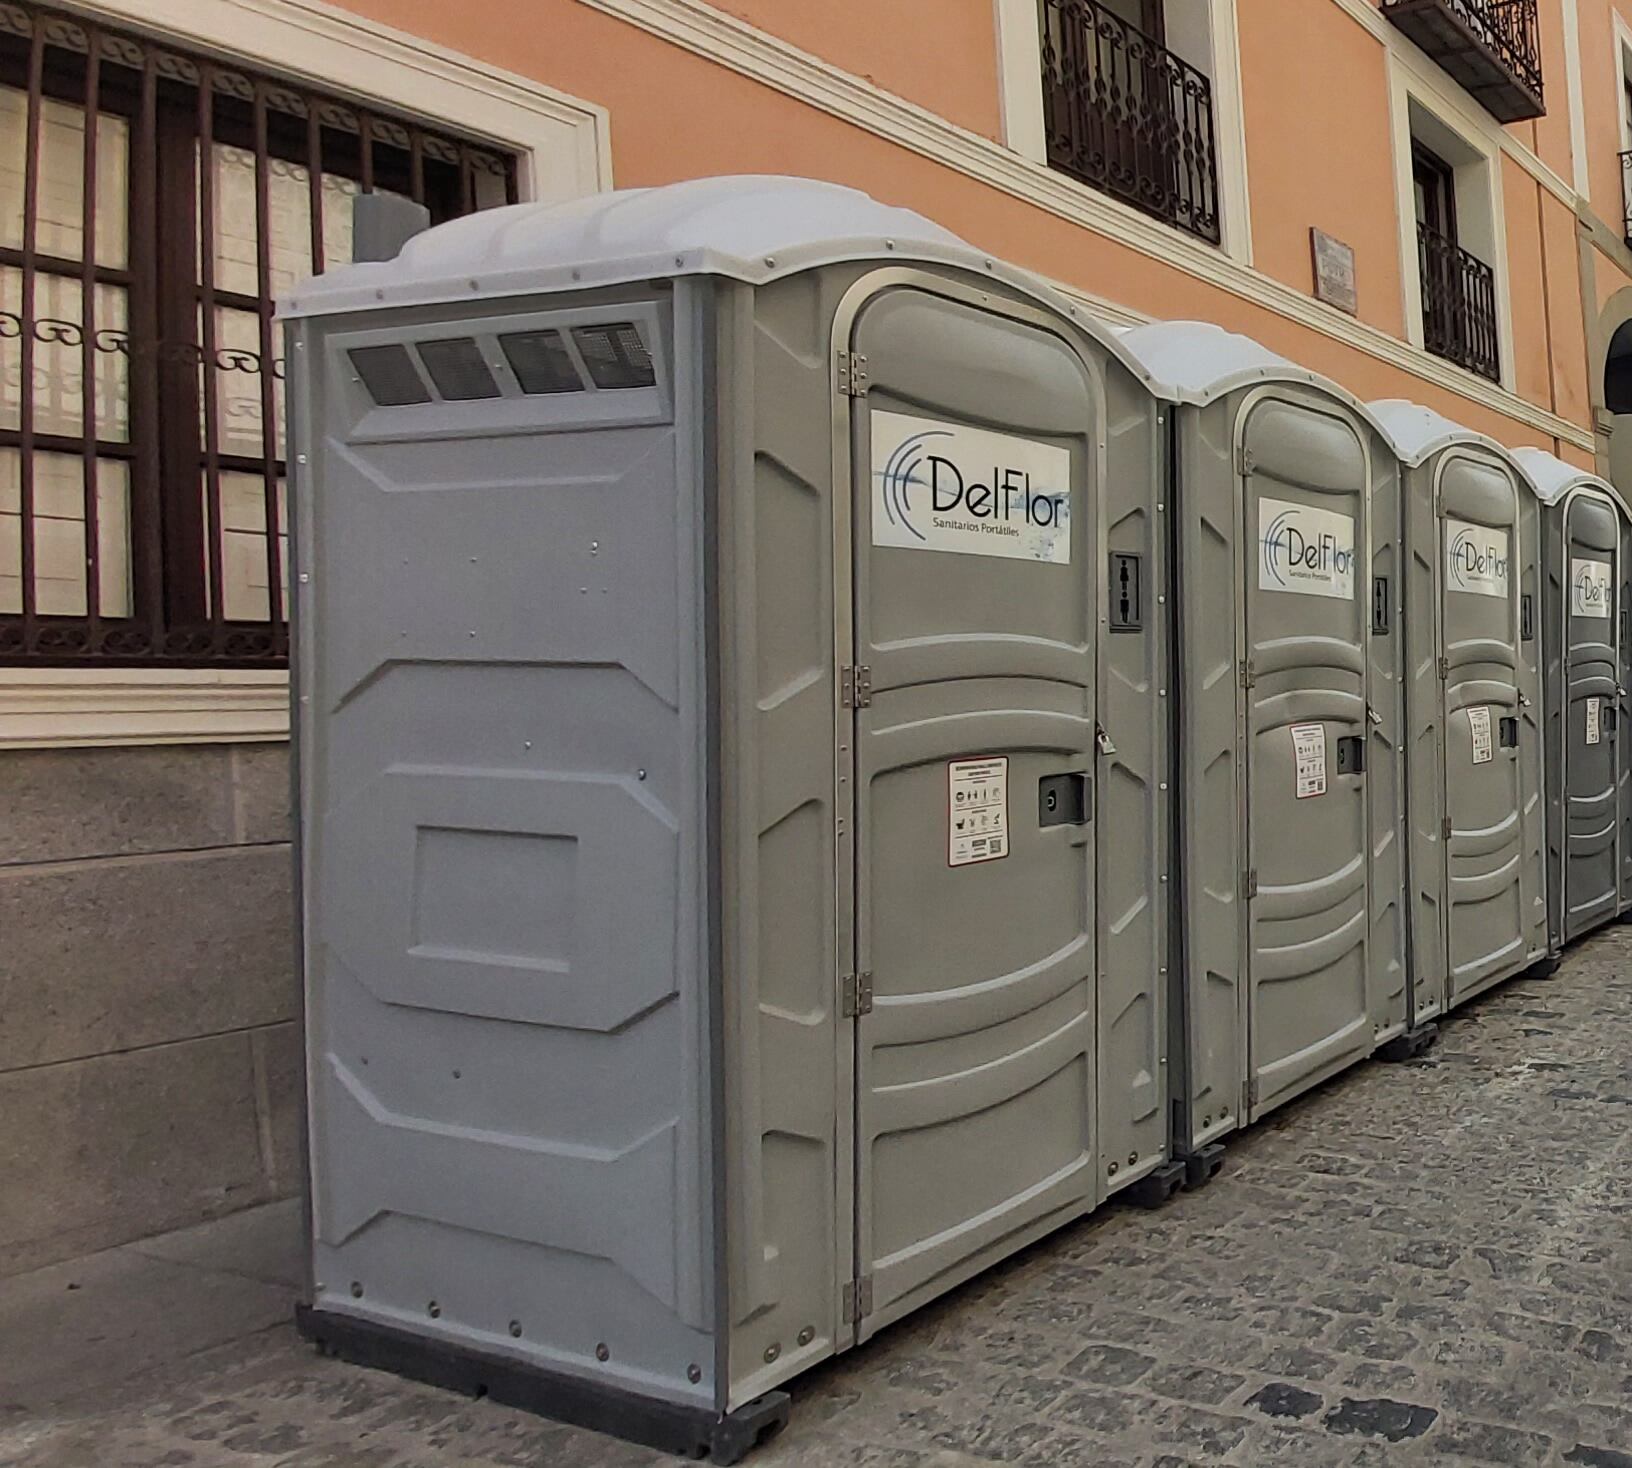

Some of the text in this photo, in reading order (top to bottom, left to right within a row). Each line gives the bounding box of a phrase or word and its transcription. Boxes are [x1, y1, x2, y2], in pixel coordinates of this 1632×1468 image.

[926, 455, 1064, 528] DelFlor
[932, 517, 1020, 537] Sanitarios Portátiles
[1286, 527, 1352, 575] DelFlor
